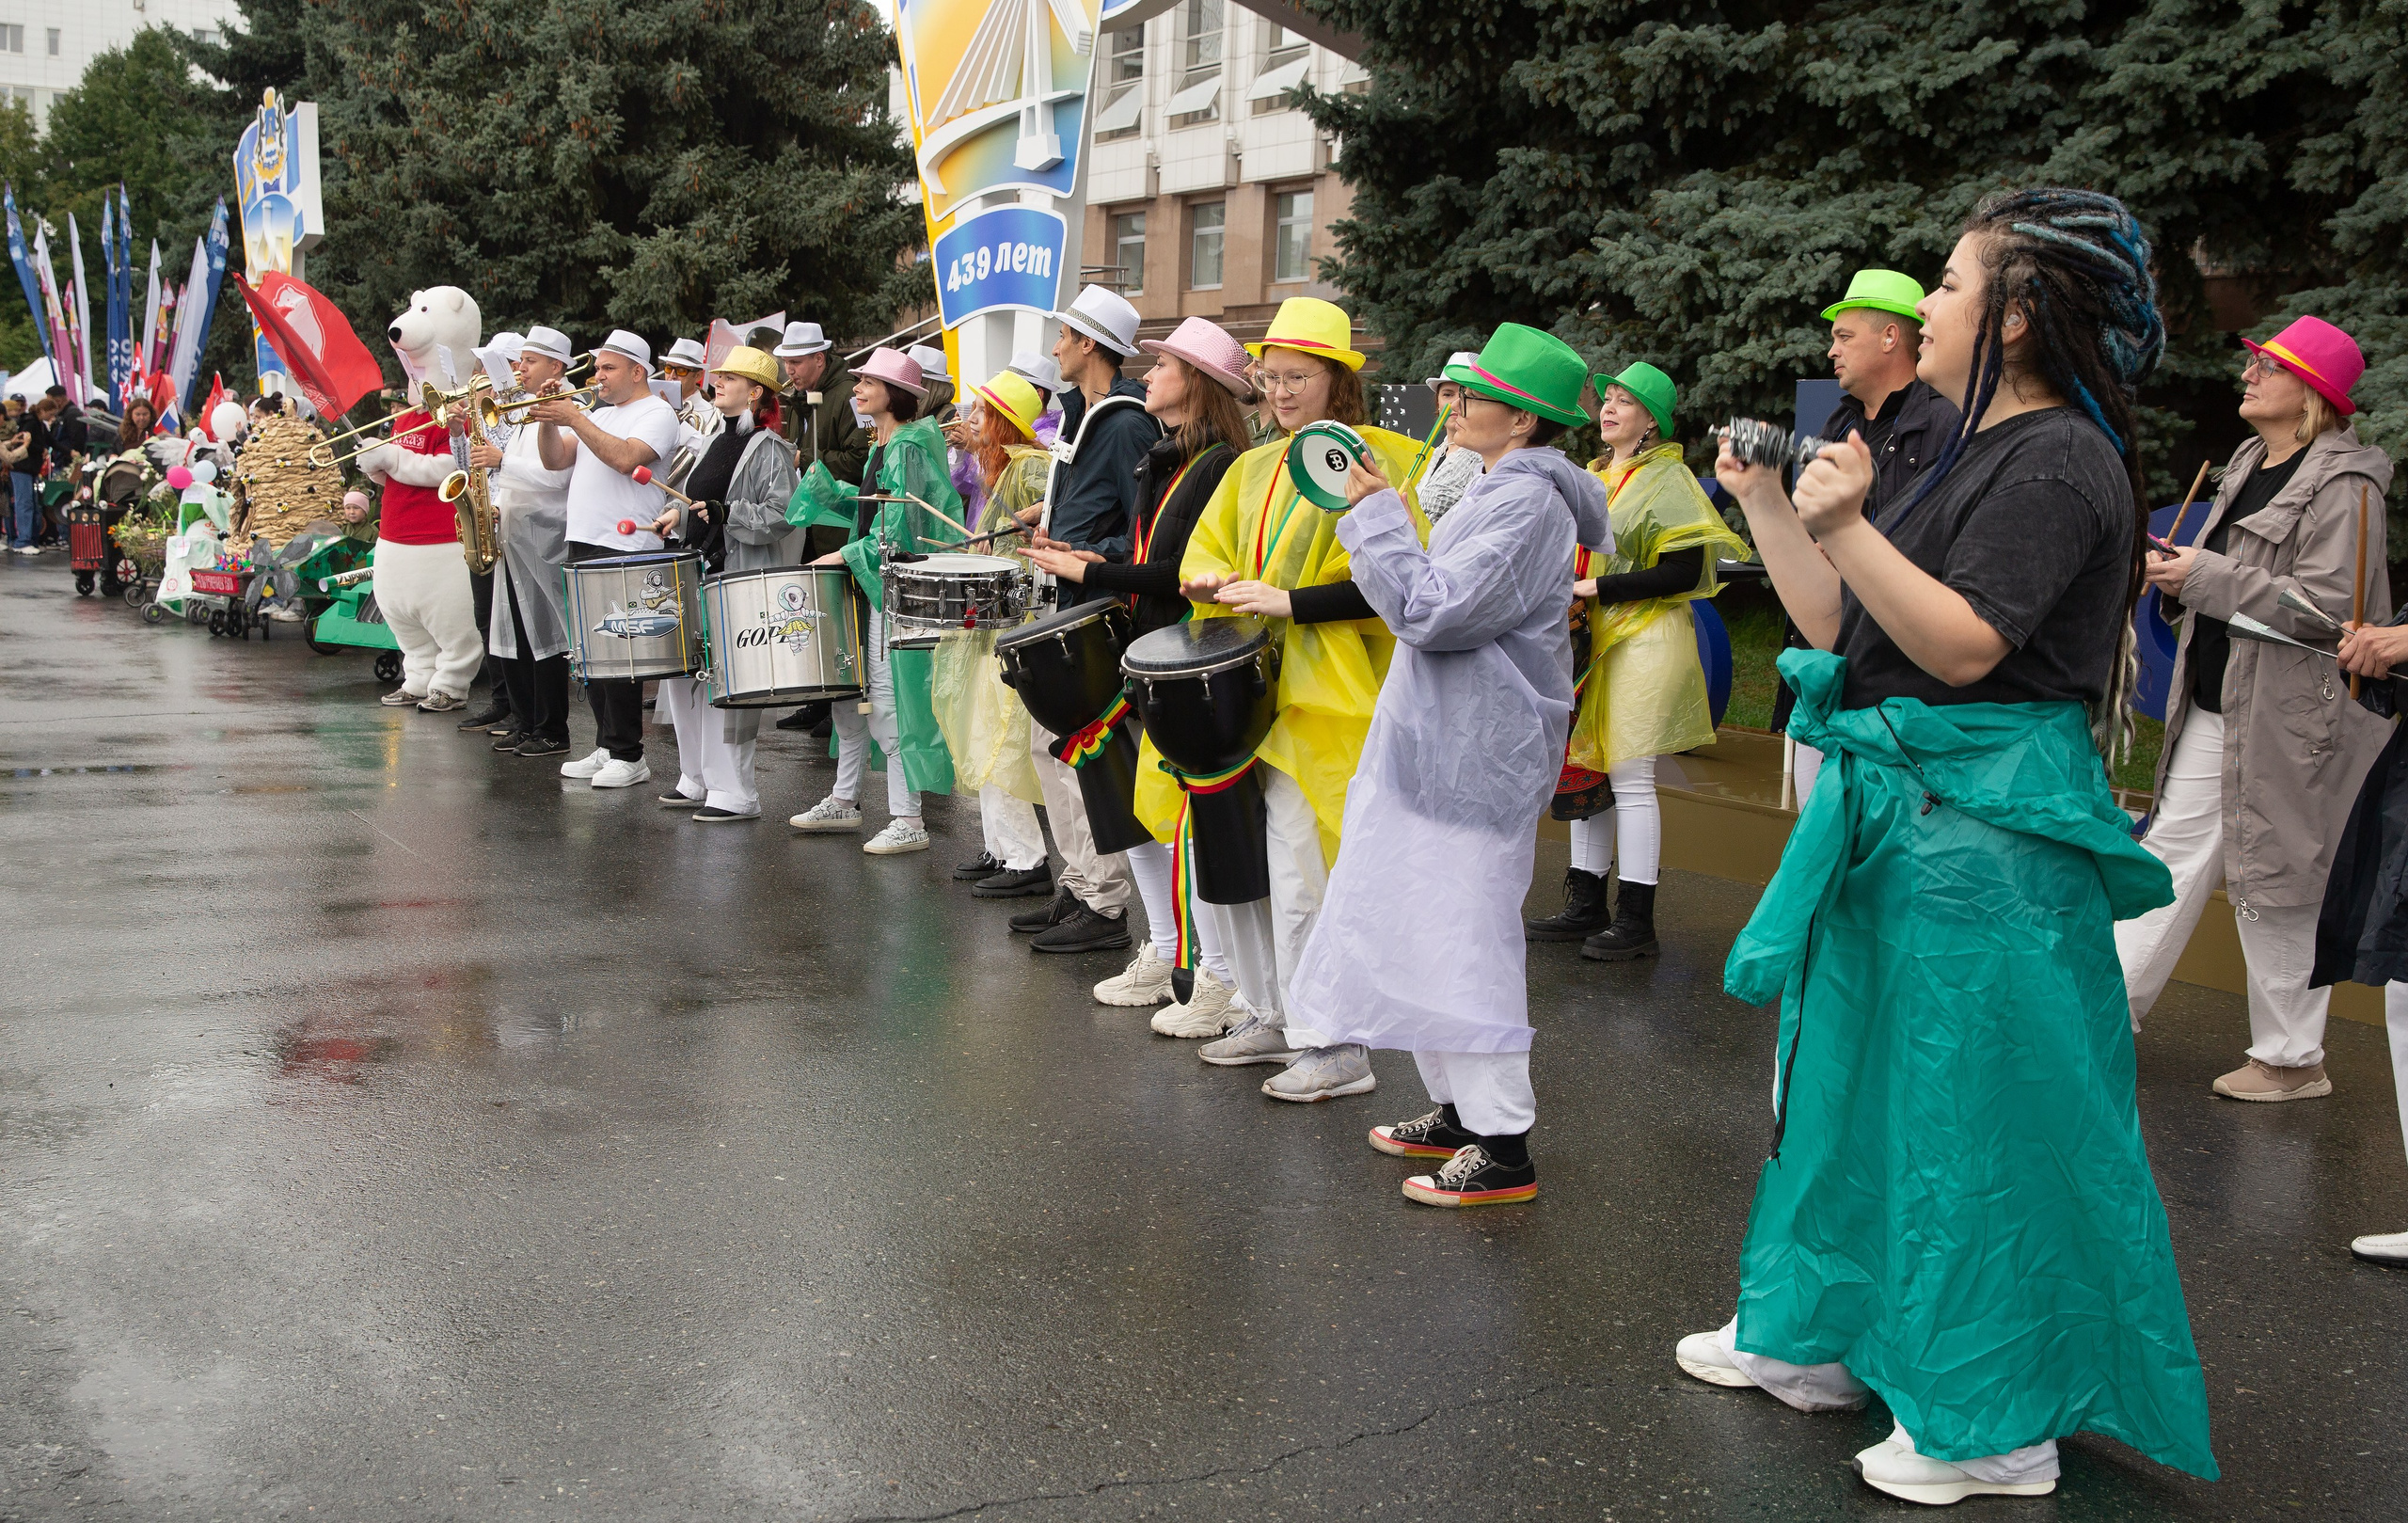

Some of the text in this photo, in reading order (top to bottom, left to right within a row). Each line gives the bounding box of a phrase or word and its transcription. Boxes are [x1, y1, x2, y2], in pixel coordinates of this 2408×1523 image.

[946, 242, 1052, 293] 439 лет
[610, 619, 655, 634] MSF
